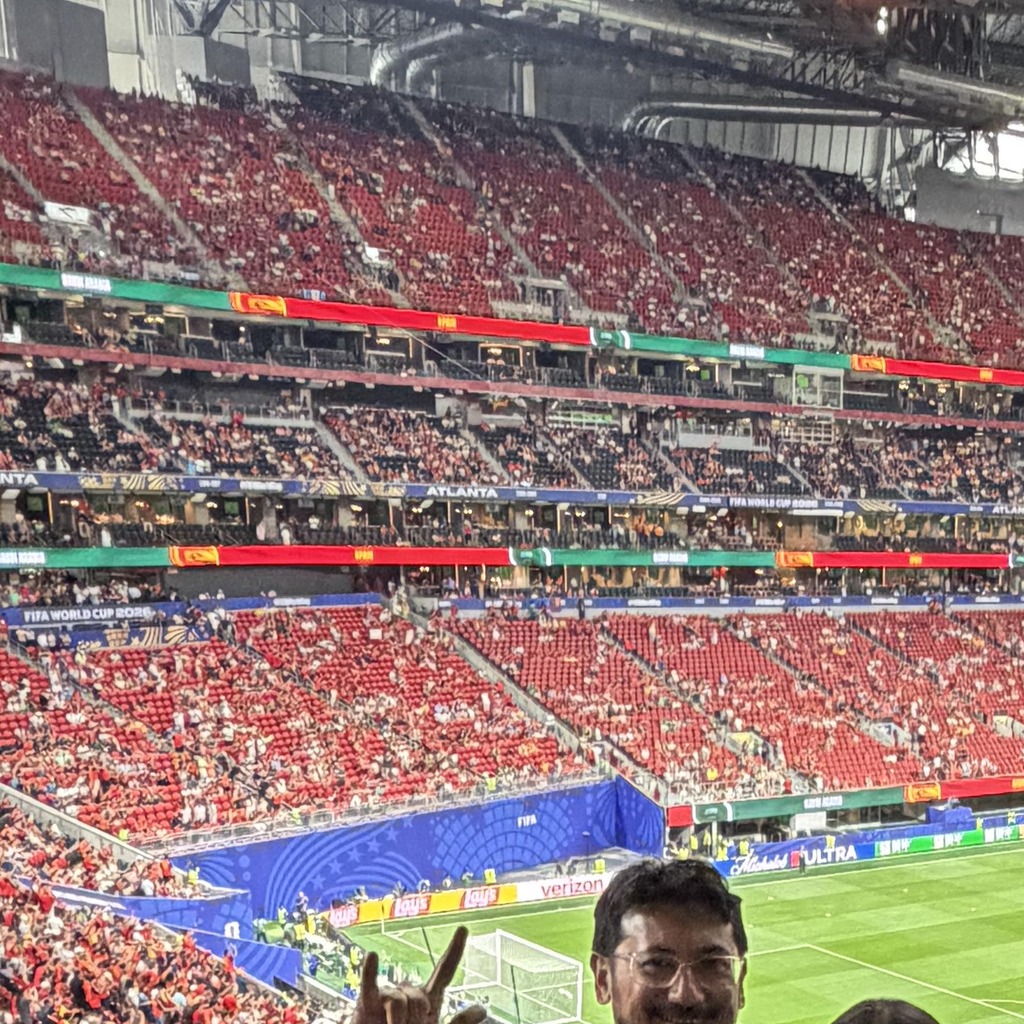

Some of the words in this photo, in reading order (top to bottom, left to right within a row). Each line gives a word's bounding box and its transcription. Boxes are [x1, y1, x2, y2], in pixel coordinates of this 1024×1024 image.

[427, 486, 498, 498] ATLANTA
[24, 609, 49, 622] FIFA
[51, 608, 90, 621] WORLD
[92, 607, 114, 619] CUP
[517, 815, 536, 827] FIFA
[803, 845, 857, 866] ULTRA
[541, 879, 603, 897] verizon
